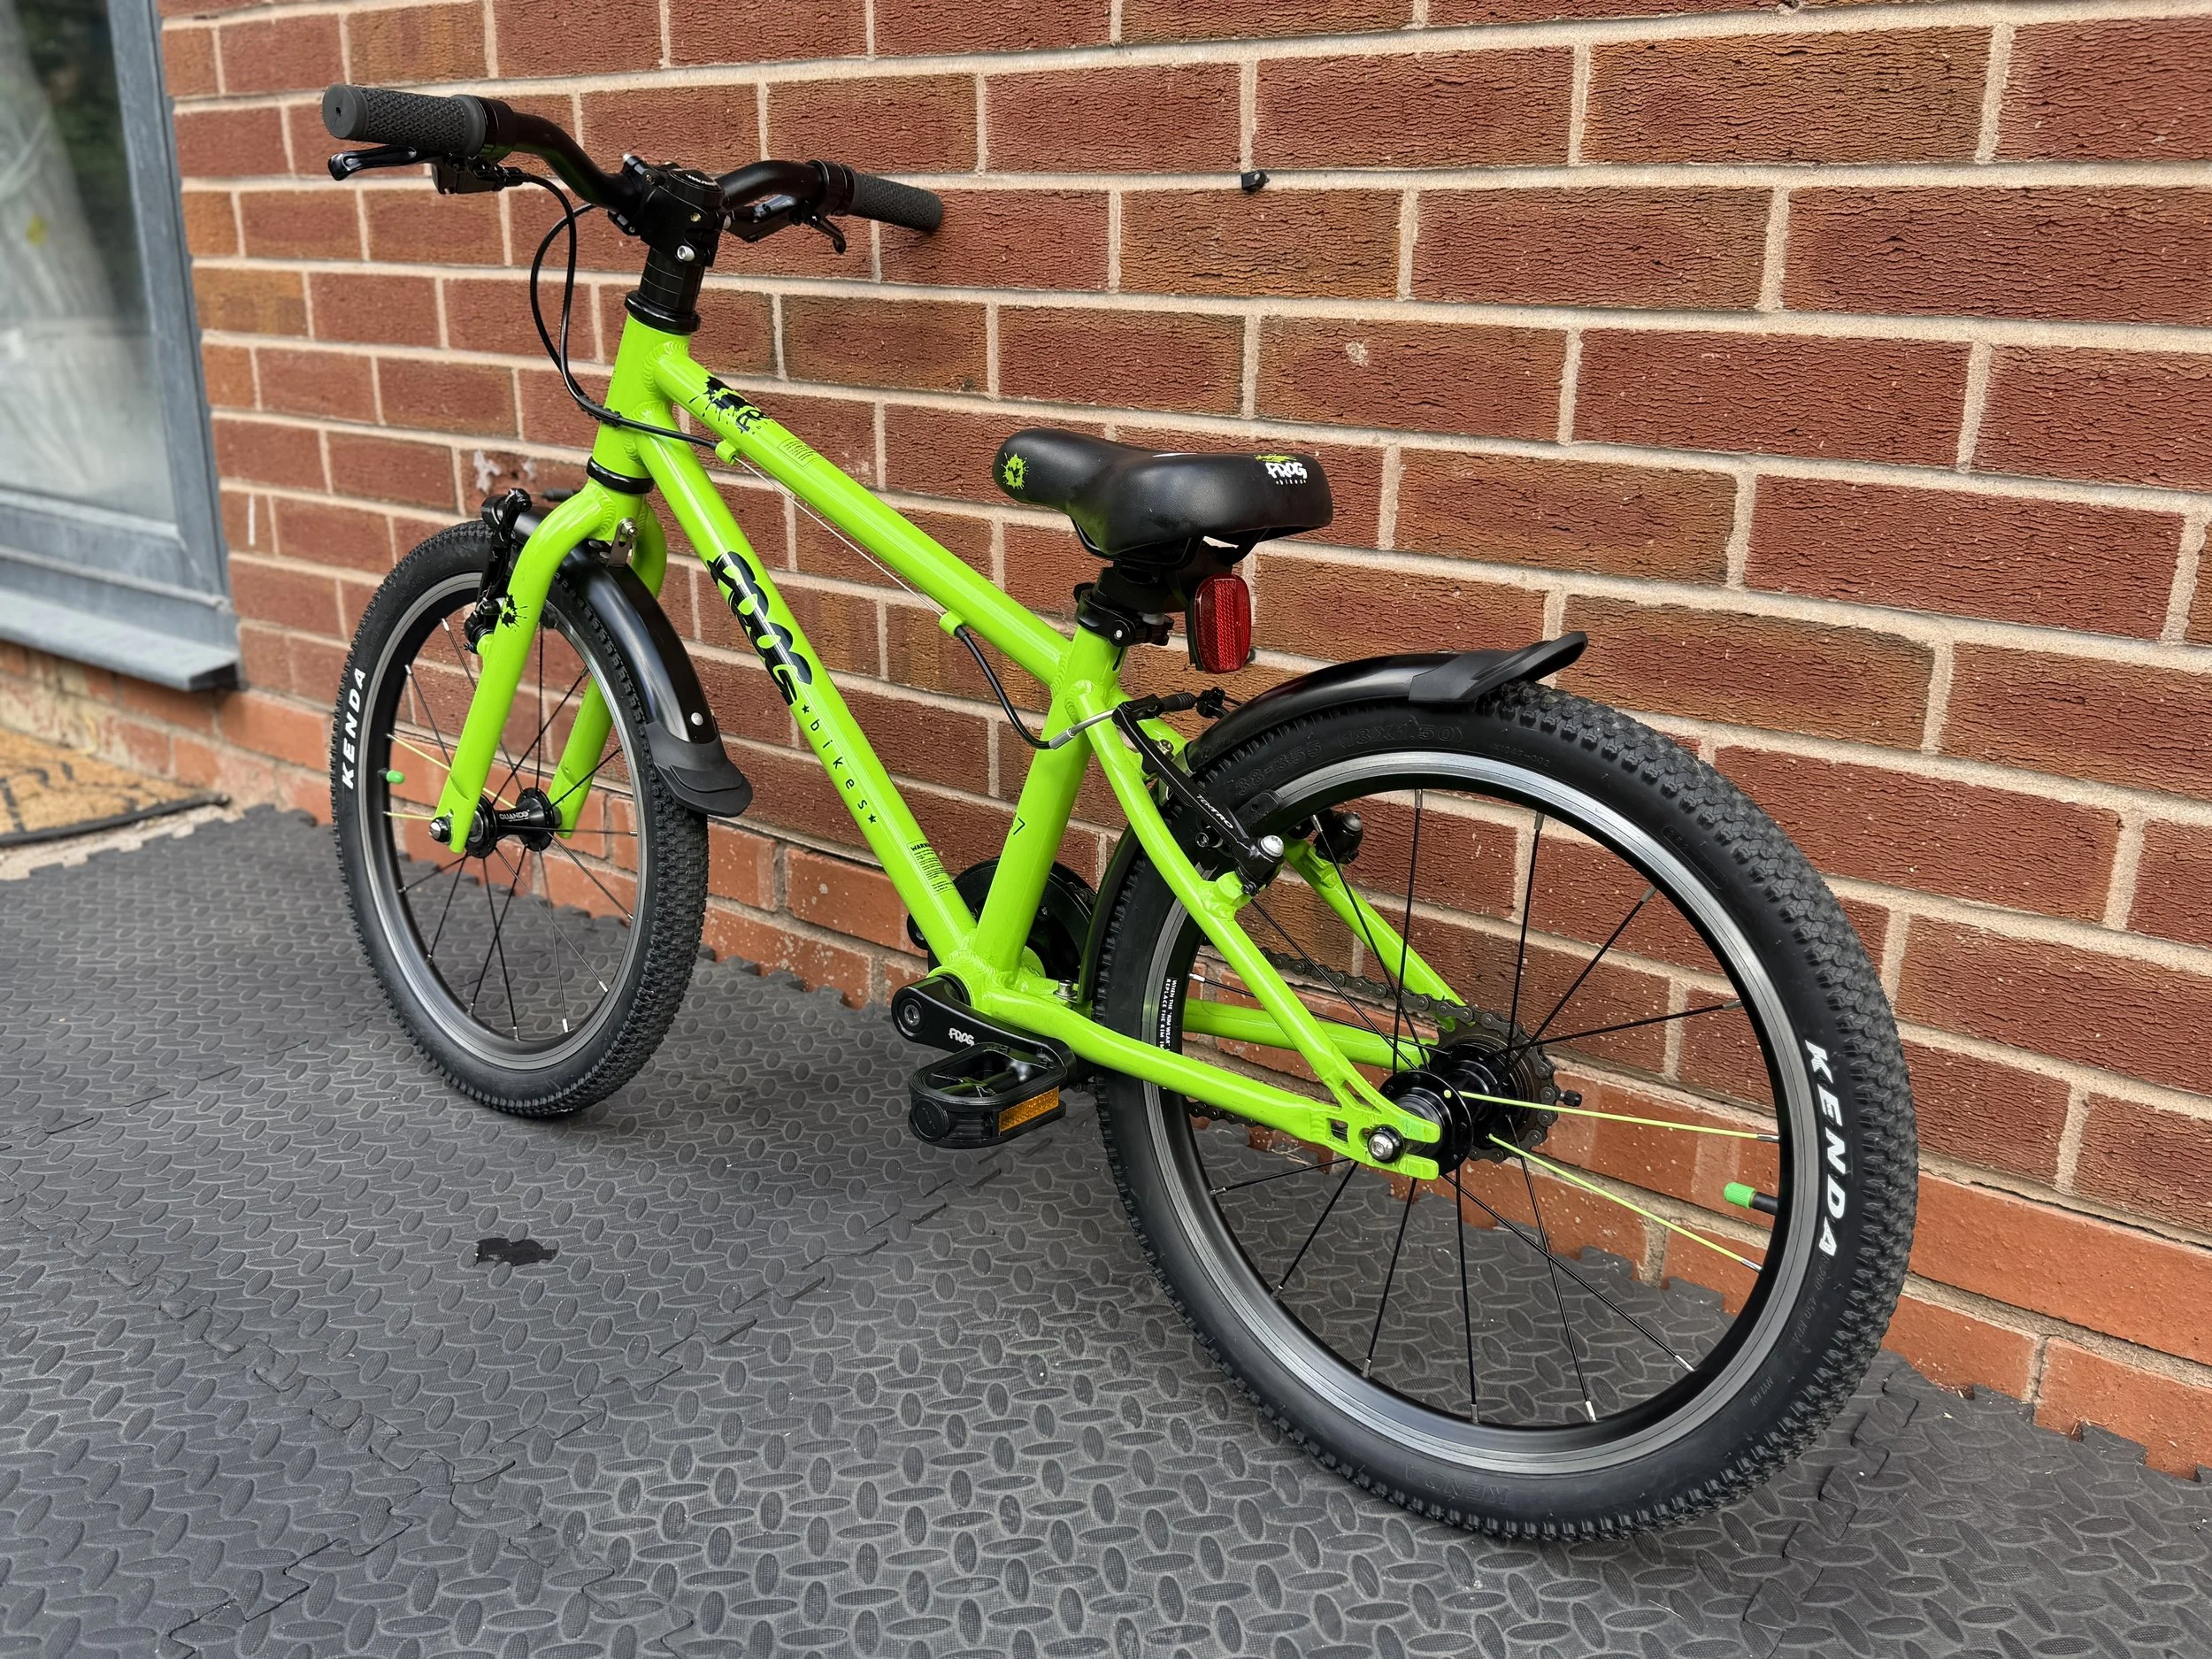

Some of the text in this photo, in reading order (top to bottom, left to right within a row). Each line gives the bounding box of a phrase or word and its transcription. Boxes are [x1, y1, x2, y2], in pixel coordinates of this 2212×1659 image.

[1265, 461, 1308, 479] FROG
[342, 668, 365, 789] KENDA
[810, 718, 868, 810] bikes
[1238, 738, 1324, 796] 38-355
[1163, 979, 1171, 1008] REPLACE
[949, 1027, 975, 1047] FROG
[1805, 1040, 1846, 1256] KENDA
